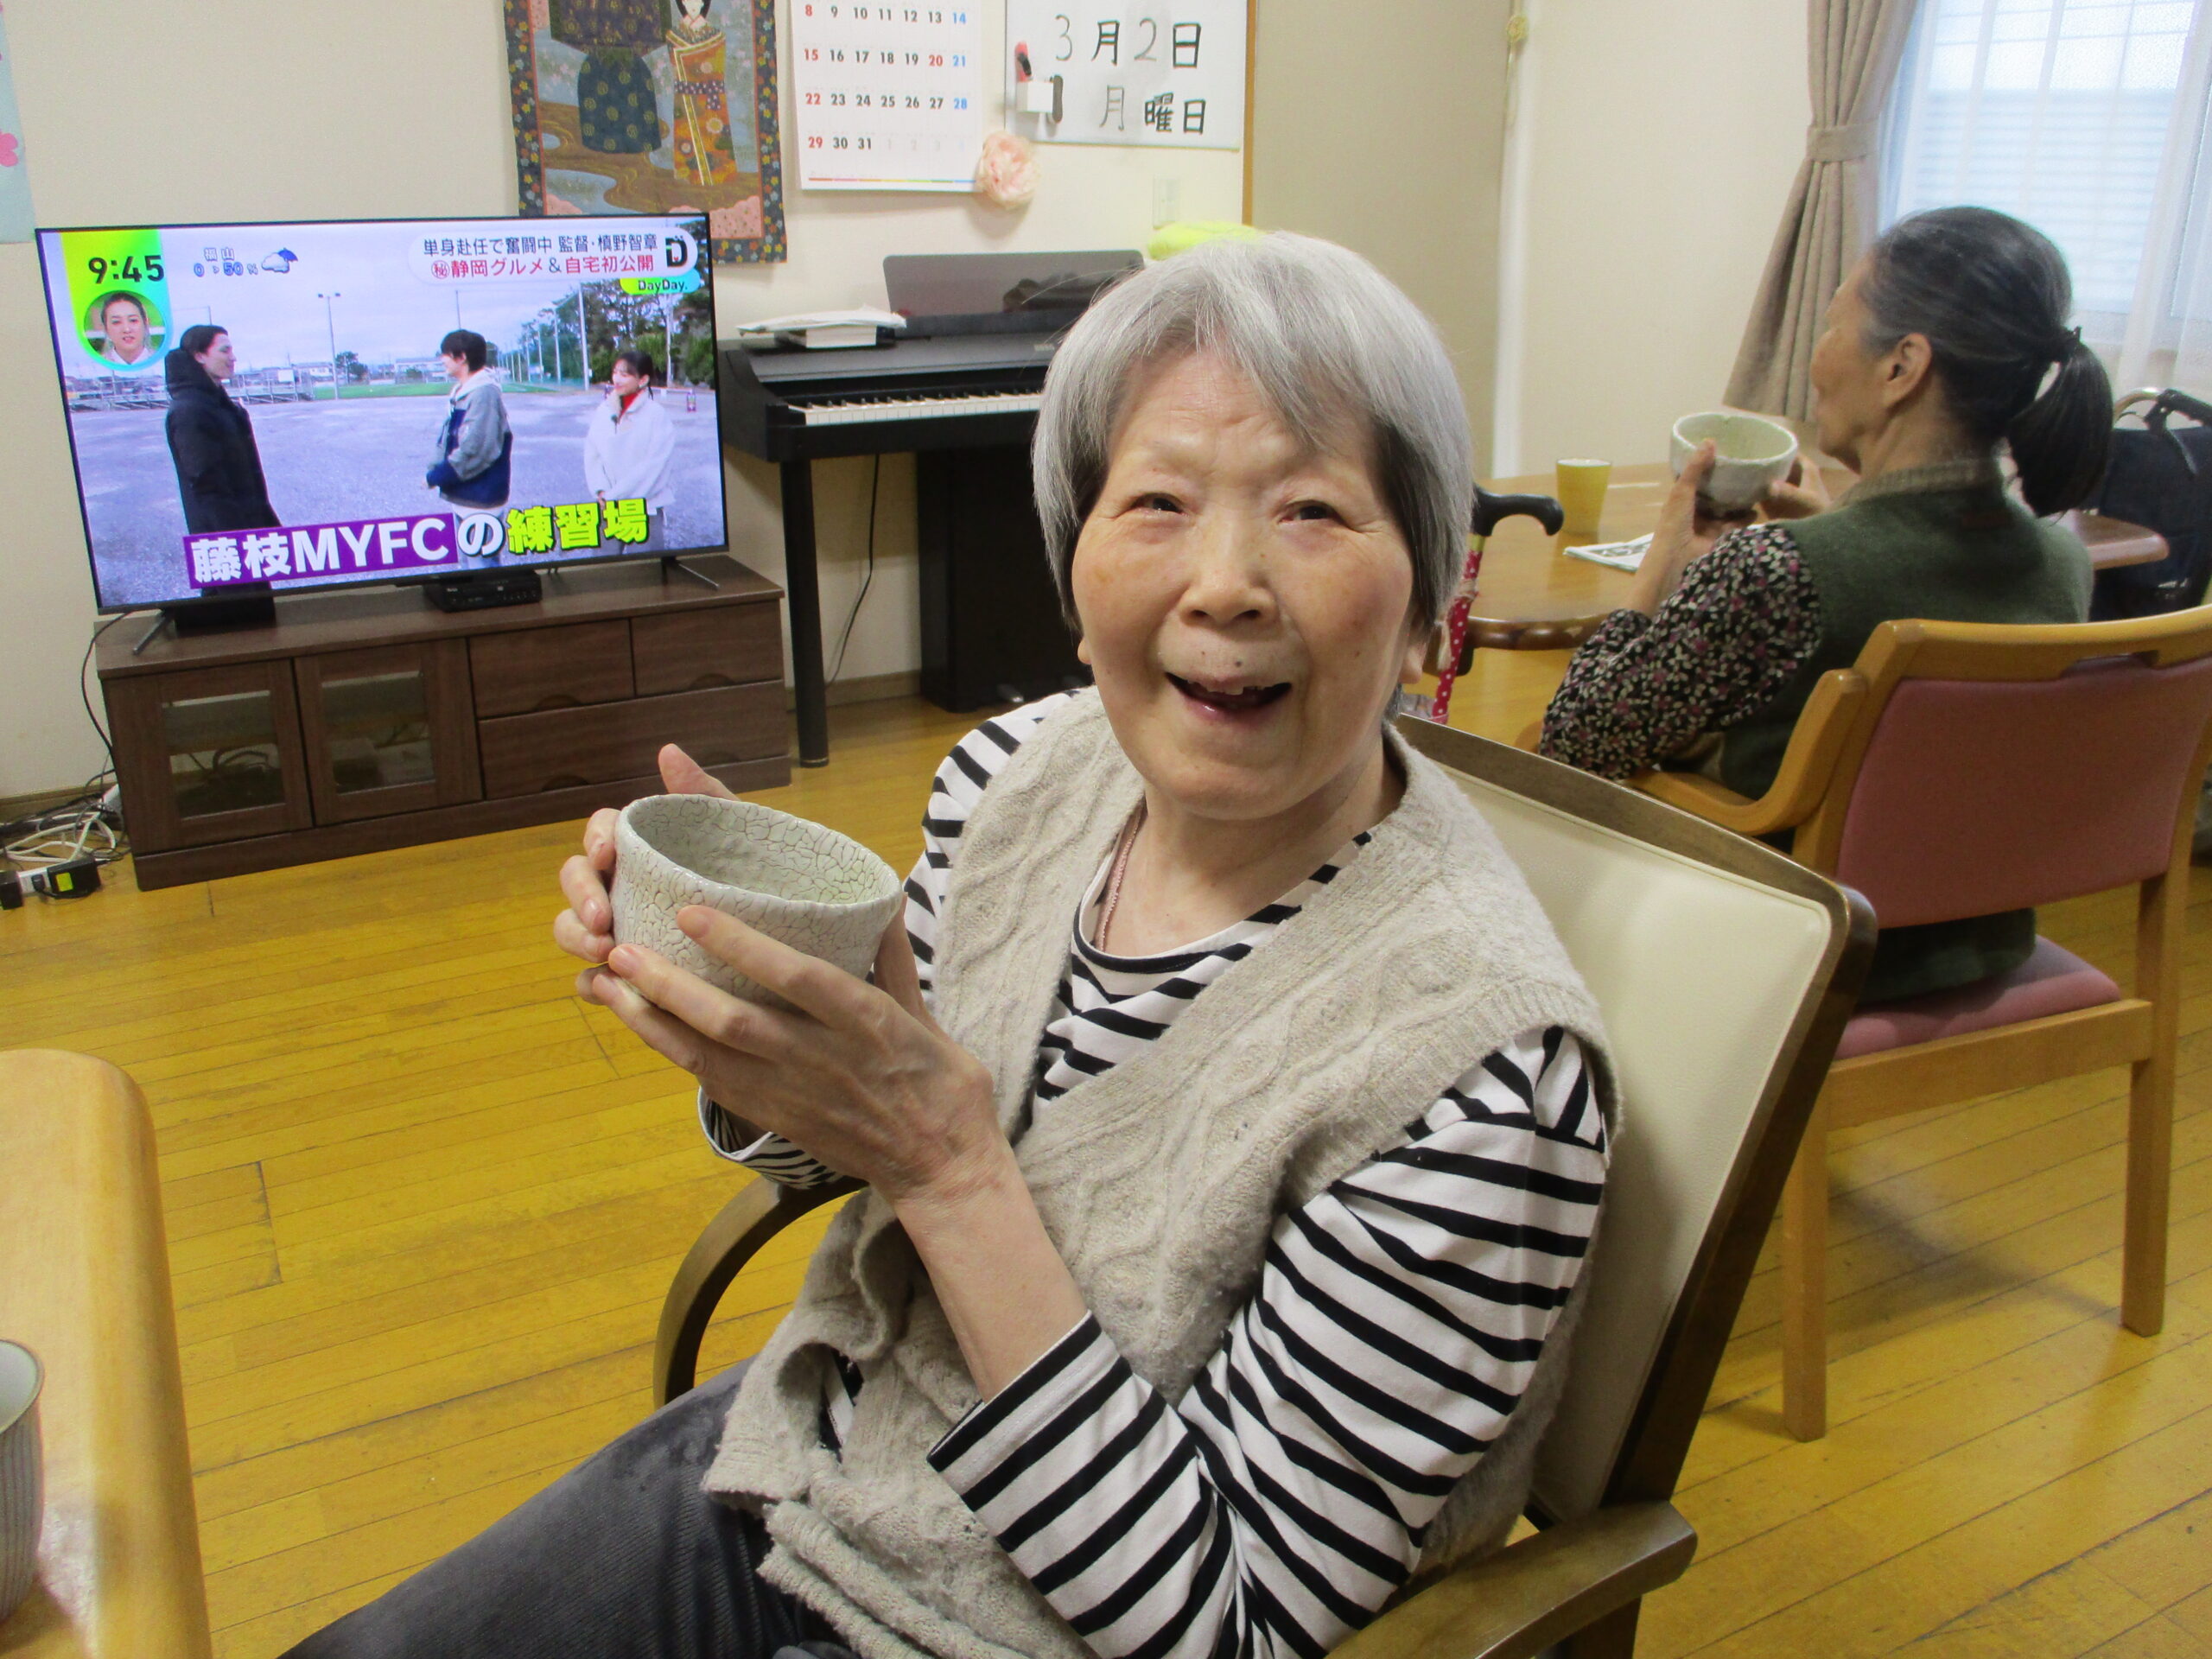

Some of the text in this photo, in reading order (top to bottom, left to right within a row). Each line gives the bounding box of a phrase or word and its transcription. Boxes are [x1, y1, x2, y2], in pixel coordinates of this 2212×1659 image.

[804, 4, 966, 24] 8 9 10 11 12 13 14
[1056, 14, 1201, 68] 3月2日
[804, 48, 966, 67] 15 16 17 18 19 20 21
[805, 92, 968, 110] 22 23 24 25 26 27 28
[1099, 85, 1206, 135] 月曜日
[808, 137, 823, 149] 29
[833, 137, 848, 149] 30
[858, 138, 872, 150] 31
[423, 236, 552, 257] 単身赴任で奮闘中
[88, 254, 164, 284] 9:45
[638, 279, 688, 294] DayDay.
